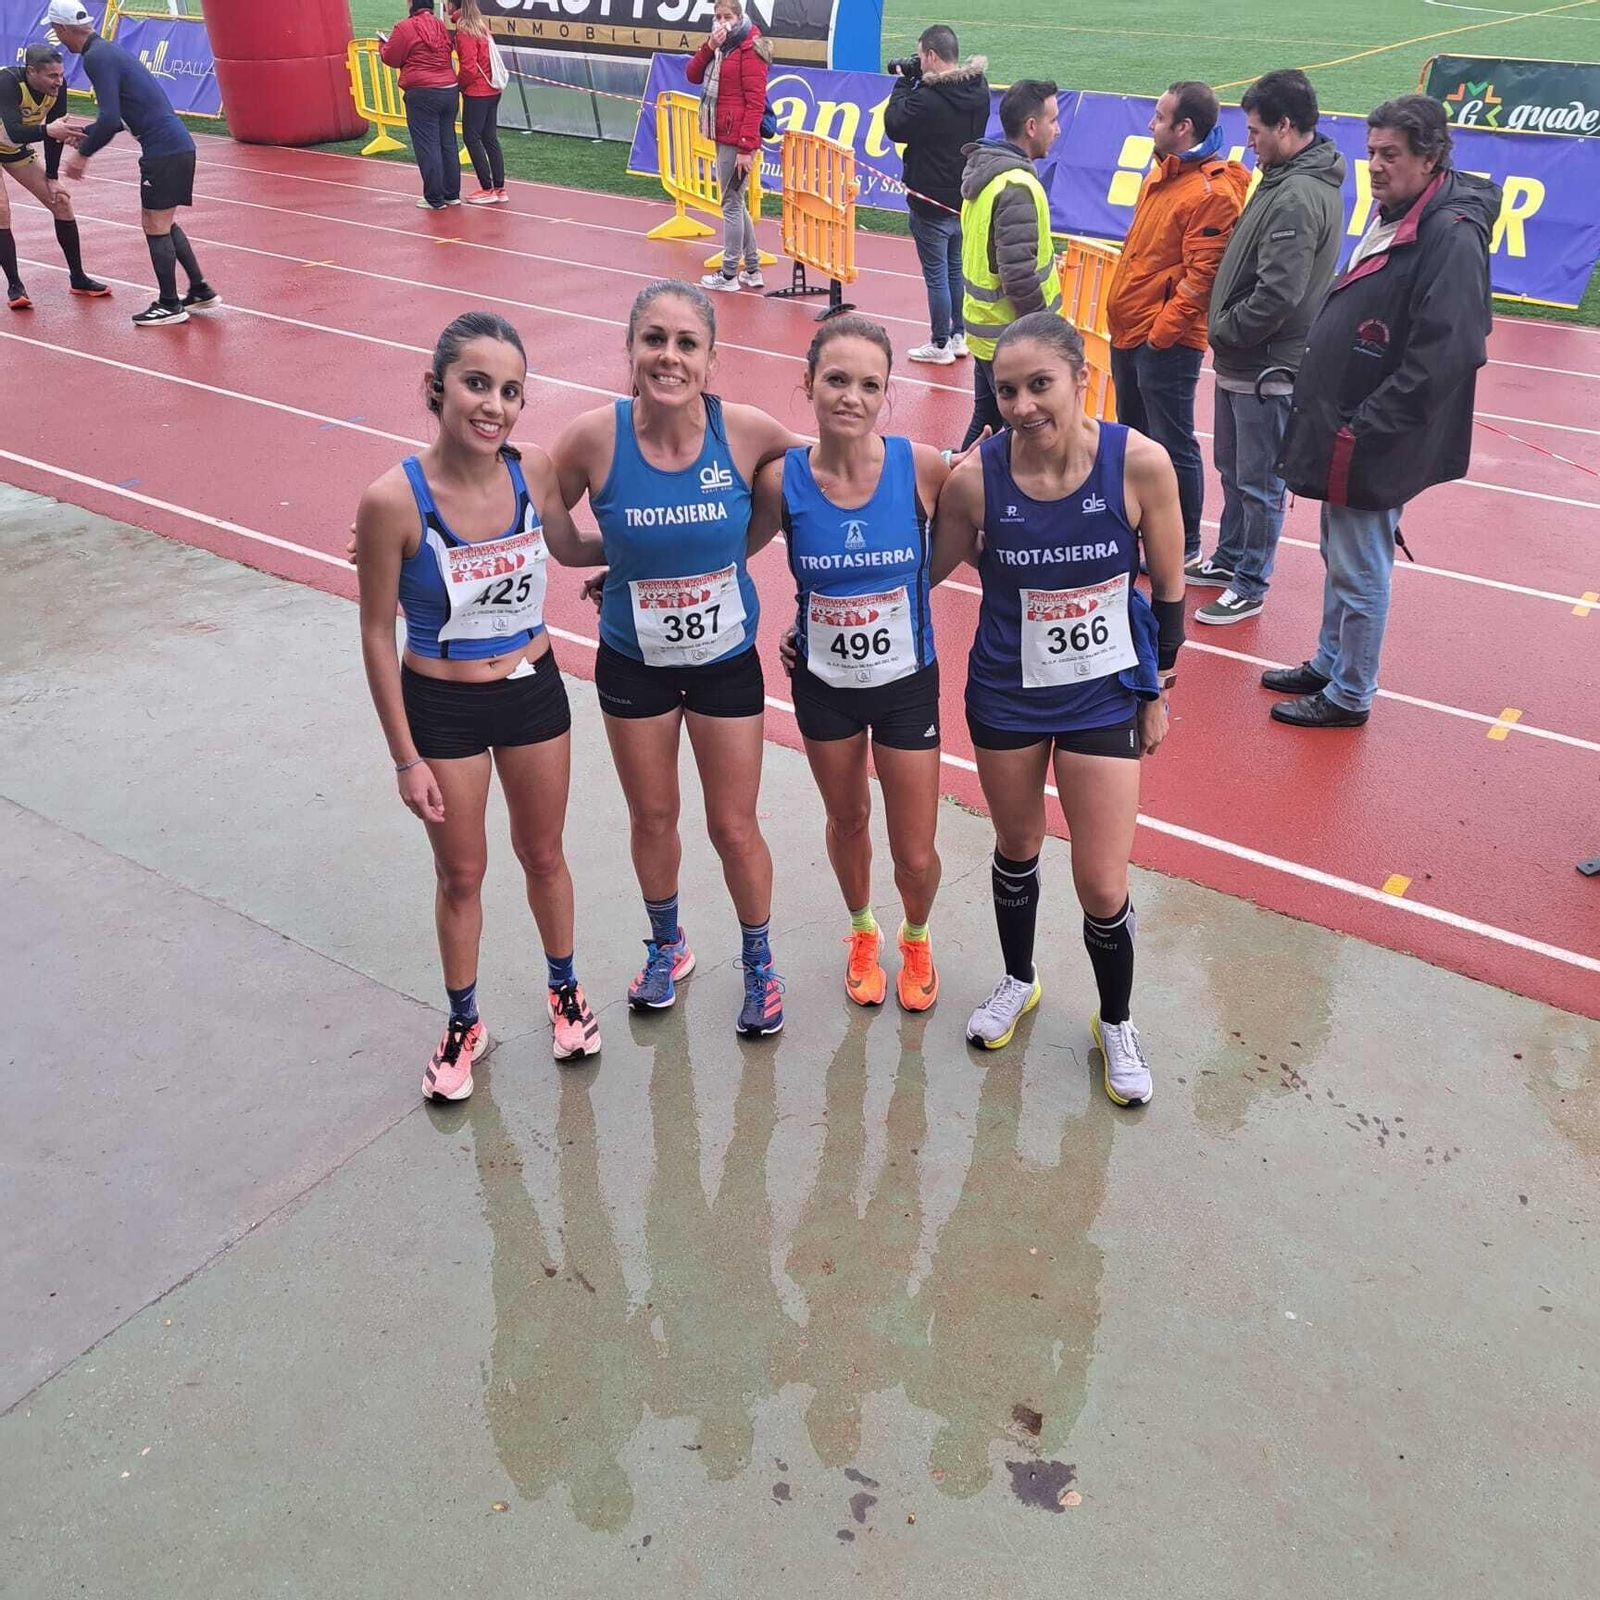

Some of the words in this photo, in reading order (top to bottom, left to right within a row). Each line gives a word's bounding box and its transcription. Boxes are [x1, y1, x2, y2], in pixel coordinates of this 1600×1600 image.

[700, 460, 733, 487] als
[625, 501, 727, 526] TROTASIERRA
[800, 547, 915, 569] TROTASIERRA
[996, 540, 1119, 565] TROTASIERRA
[472, 574, 532, 605] 425
[663, 604, 720, 642] 387
[1047, 616, 1108, 654] 366
[831, 628, 891, 660] 496
